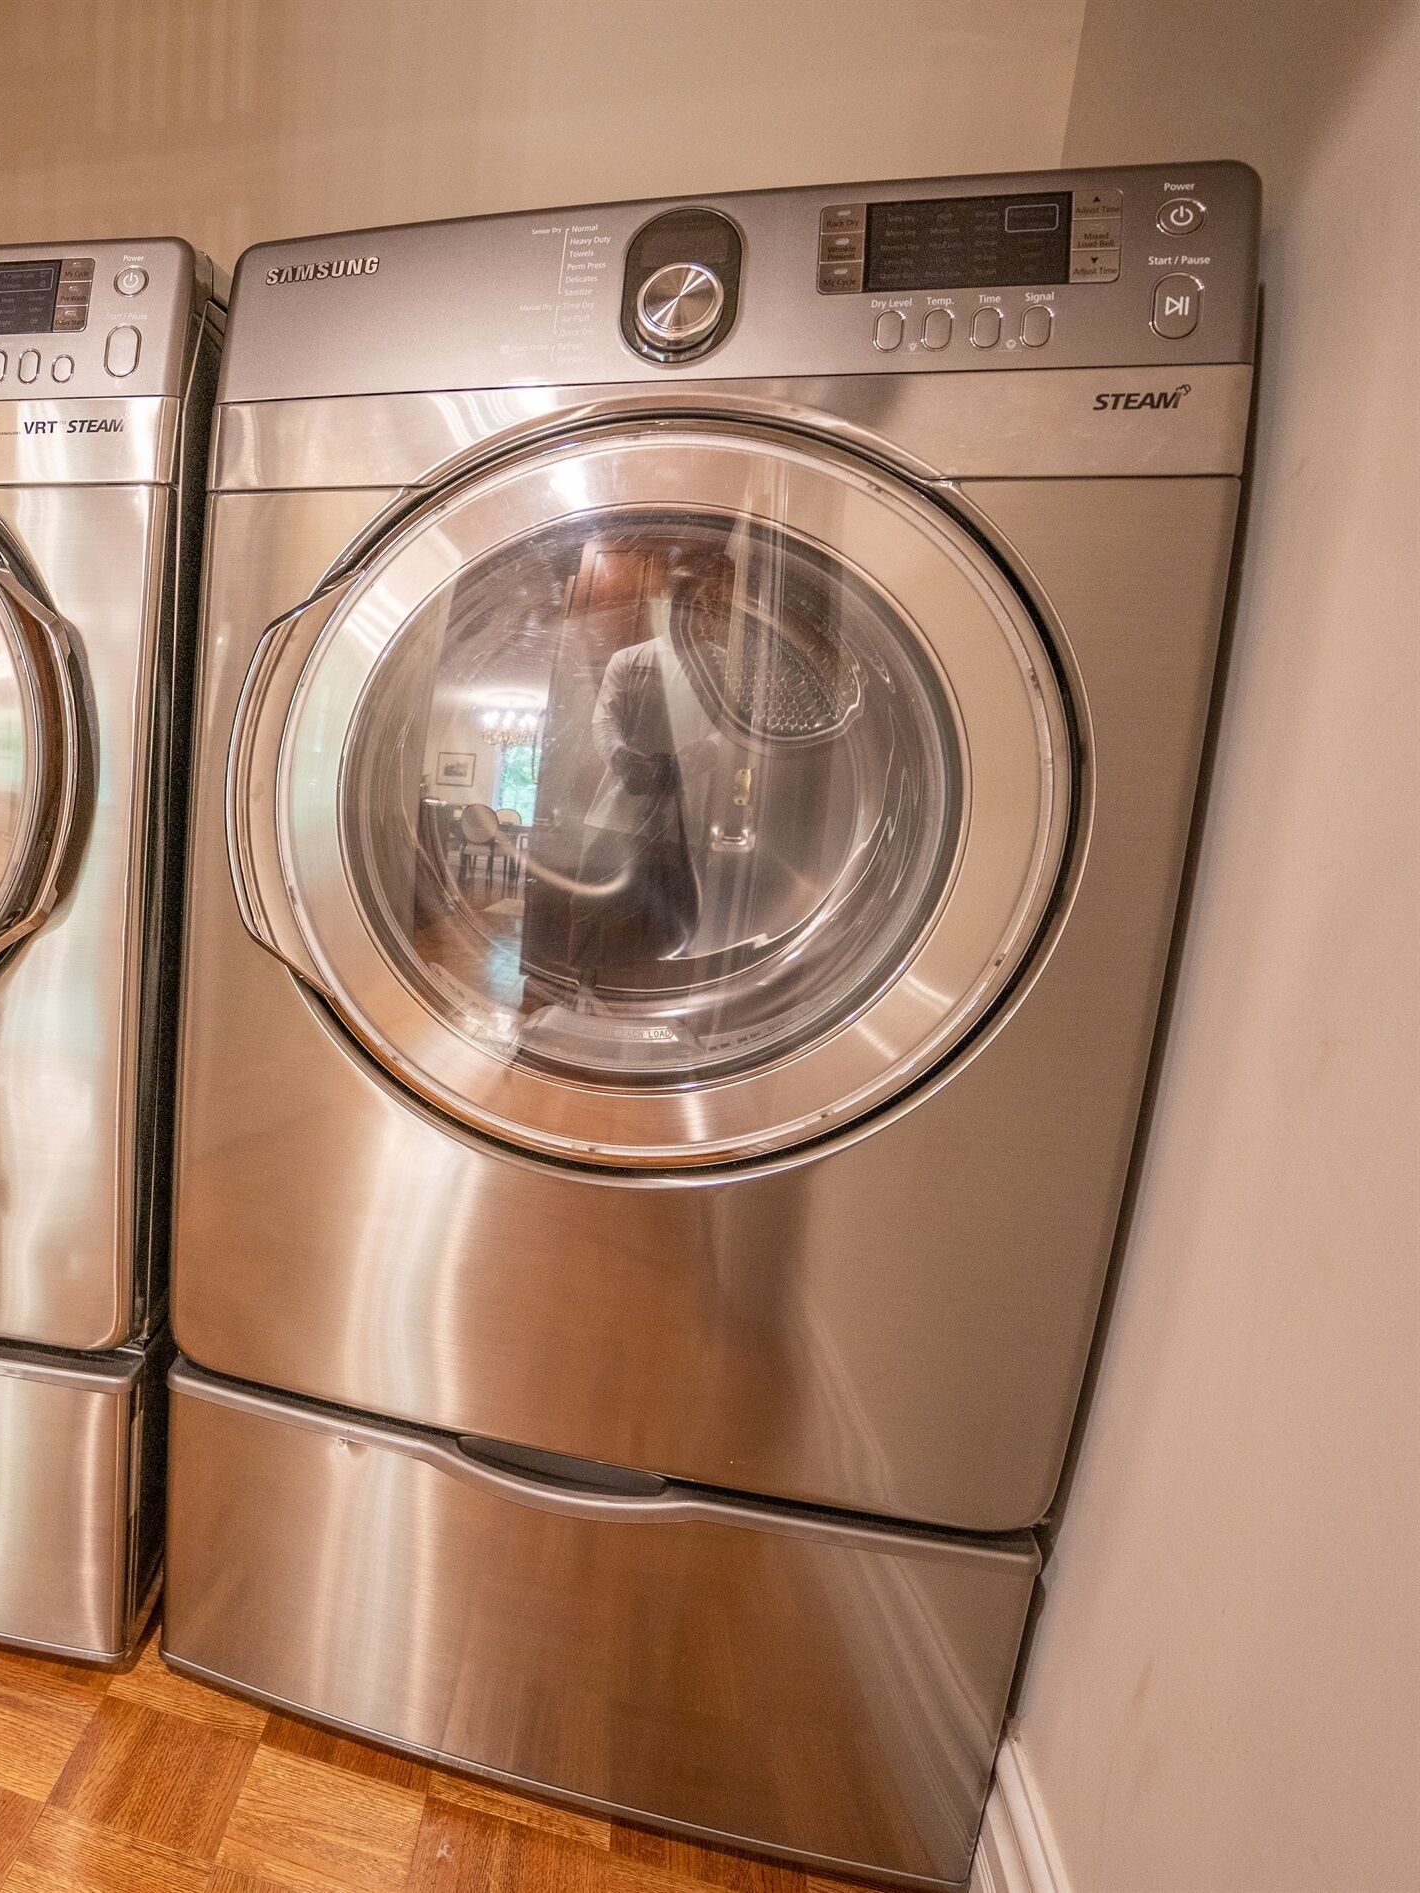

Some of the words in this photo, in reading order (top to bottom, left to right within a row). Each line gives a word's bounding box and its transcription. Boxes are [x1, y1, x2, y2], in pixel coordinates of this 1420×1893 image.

[1163, 182, 1196, 191] Power
[1075, 206, 1100, 215] Adjust
[1102, 205, 1120, 214] Time
[571, 223, 599, 233] Normal
[846, 219, 860, 228] Dry
[1084, 232, 1109, 240] Mixed
[569, 237, 593, 246] Heavy
[593, 236, 612, 245] Duty
[123, 254, 145, 262] Power
[569, 249, 594, 258] Towels
[1148, 256, 1172, 266] Start
[1180, 255, 1211, 265] Pause
[265, 256, 380, 286] SAMSUNG
[566, 263, 586, 271] Perm
[587, 262, 607, 270] Press
[1074, 267, 1098, 276] Adjust
[1100, 267, 1118, 275] Time
[565, 275, 598, 284] Delicates
[927, 296, 955, 306] Temp.
[978, 295, 1002, 303] Time
[1025, 291, 1055, 304] Signal
[871, 299, 887, 309] Dry
[889, 298, 913, 308] Level
[1092, 391, 1181, 411] STEAM
[66, 419, 125, 433] STEAM
[648, 1030, 671, 1039] LOAD
